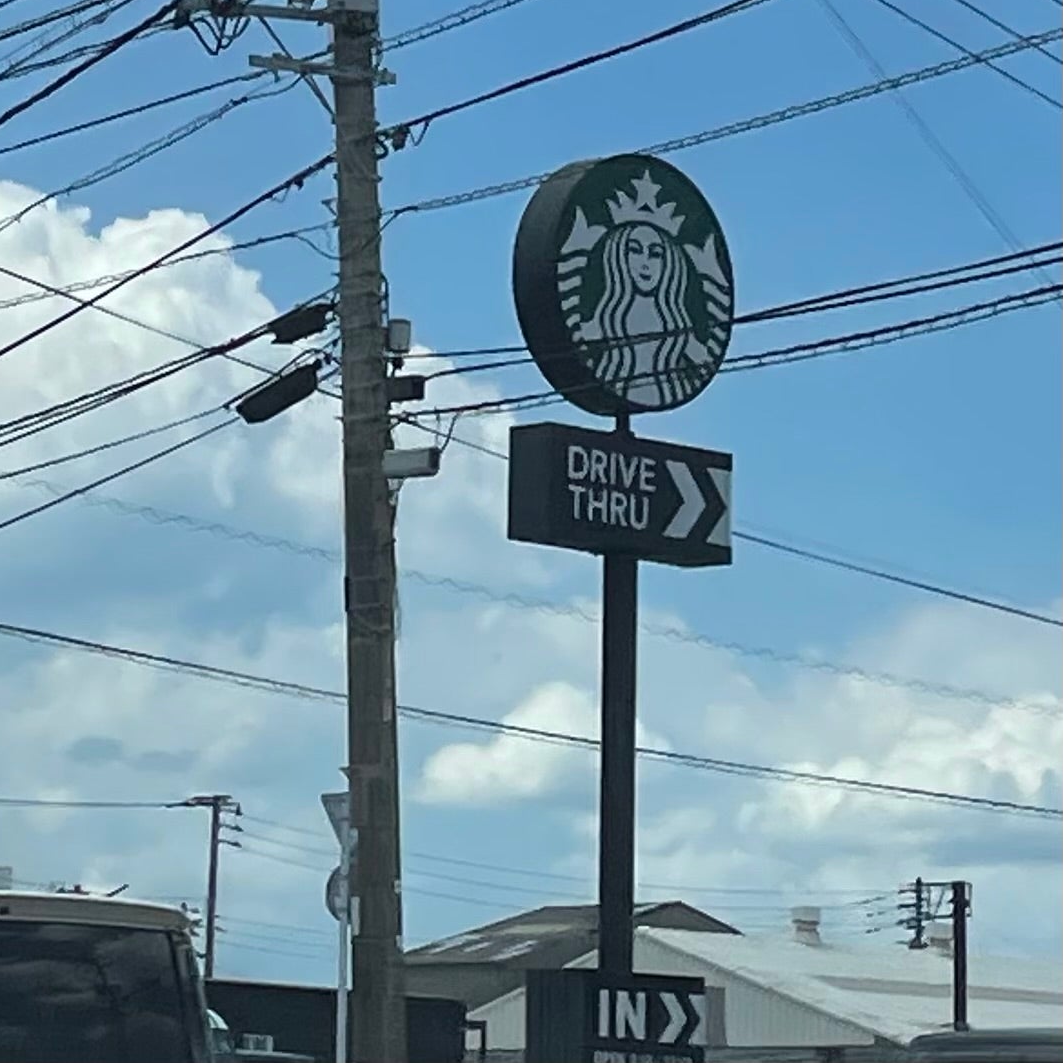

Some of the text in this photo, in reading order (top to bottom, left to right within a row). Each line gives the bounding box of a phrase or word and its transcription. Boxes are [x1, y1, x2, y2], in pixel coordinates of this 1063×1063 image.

[568, 445, 657, 492] DRIVE
[568, 484, 649, 530] THRU
[598, 988, 646, 1040] IN
